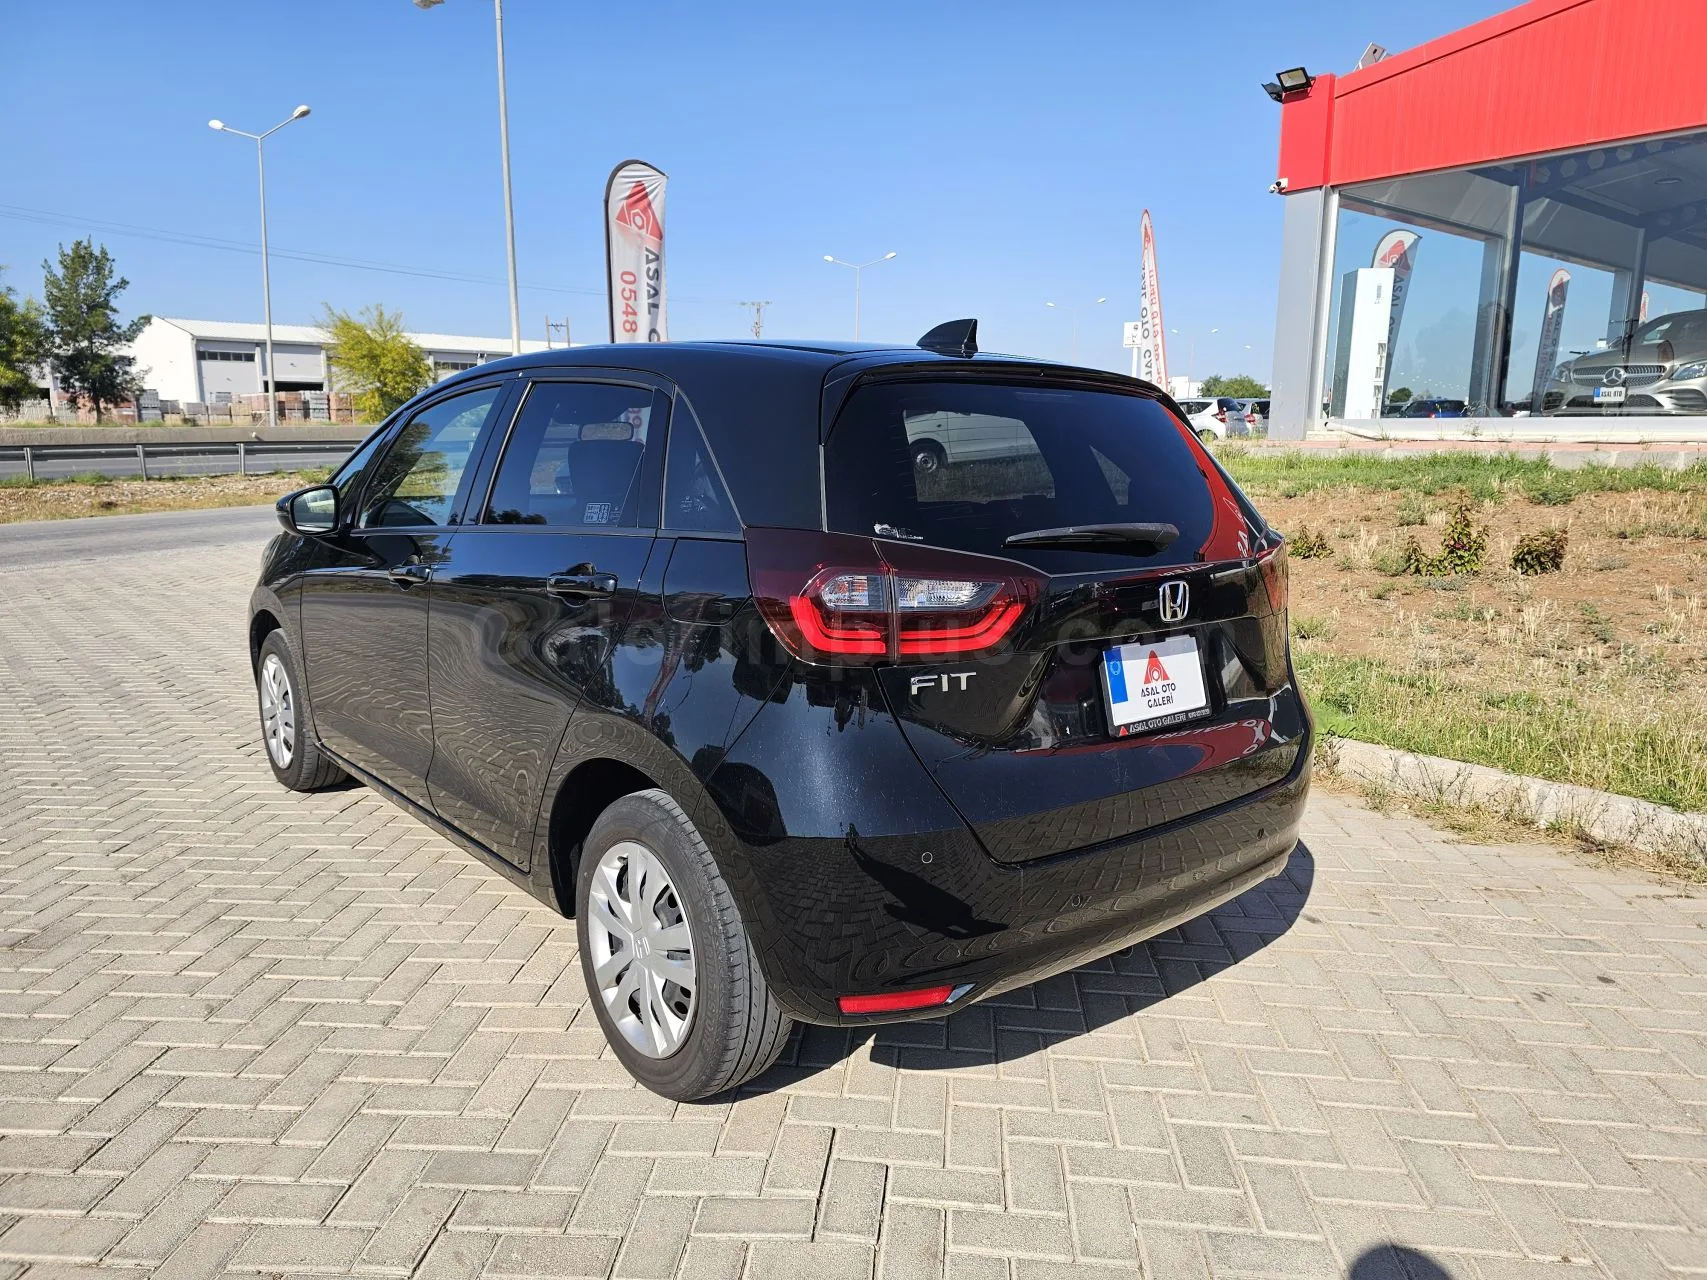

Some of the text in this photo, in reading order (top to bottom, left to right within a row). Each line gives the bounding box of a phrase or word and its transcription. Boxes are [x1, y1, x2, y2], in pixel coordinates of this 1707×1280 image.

[645, 246, 660, 315] ASAL
[621, 270, 638, 333] 0548
[911, 672, 977, 695] FIT
[1141, 682, 1177, 698] ASAL OTO
[1147, 691, 1174, 709] GALERİ
[1129, 721, 1149, 734] ASAL
[1148, 719, 1162, 729] OTO
